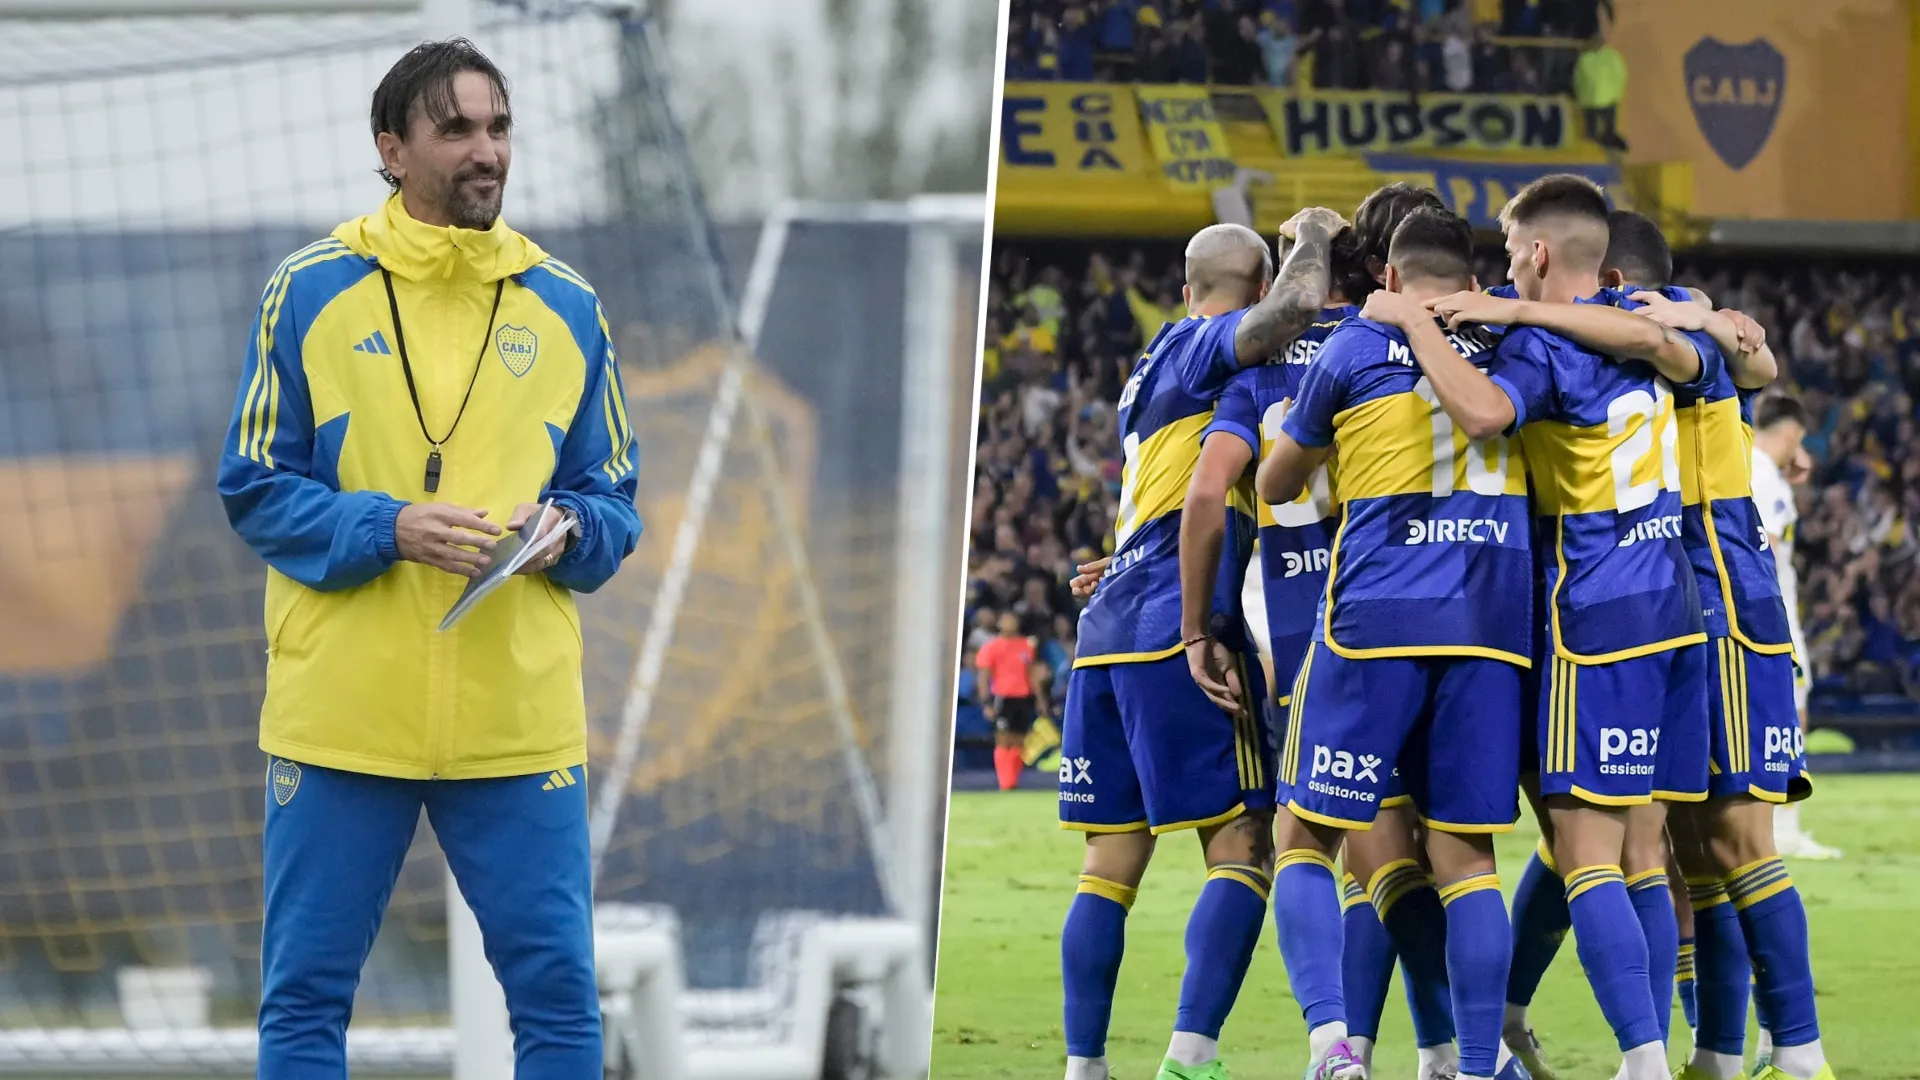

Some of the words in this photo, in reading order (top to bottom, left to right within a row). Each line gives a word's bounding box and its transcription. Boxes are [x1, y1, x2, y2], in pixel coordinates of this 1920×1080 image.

[1693, 76, 1777, 104] CABJ
[1284, 98, 1563, 155] HUDSON
[502, 341, 532, 354] CABJ
[1405, 518, 1509, 545] DIRECTV
[1281, 547, 1331, 579] DIR
[1059, 756, 1093, 785] ax
[1311, 744, 1383, 784] pax
[1599, 762, 1656, 775] assistan
[1308, 779, 1376, 803] assistance
